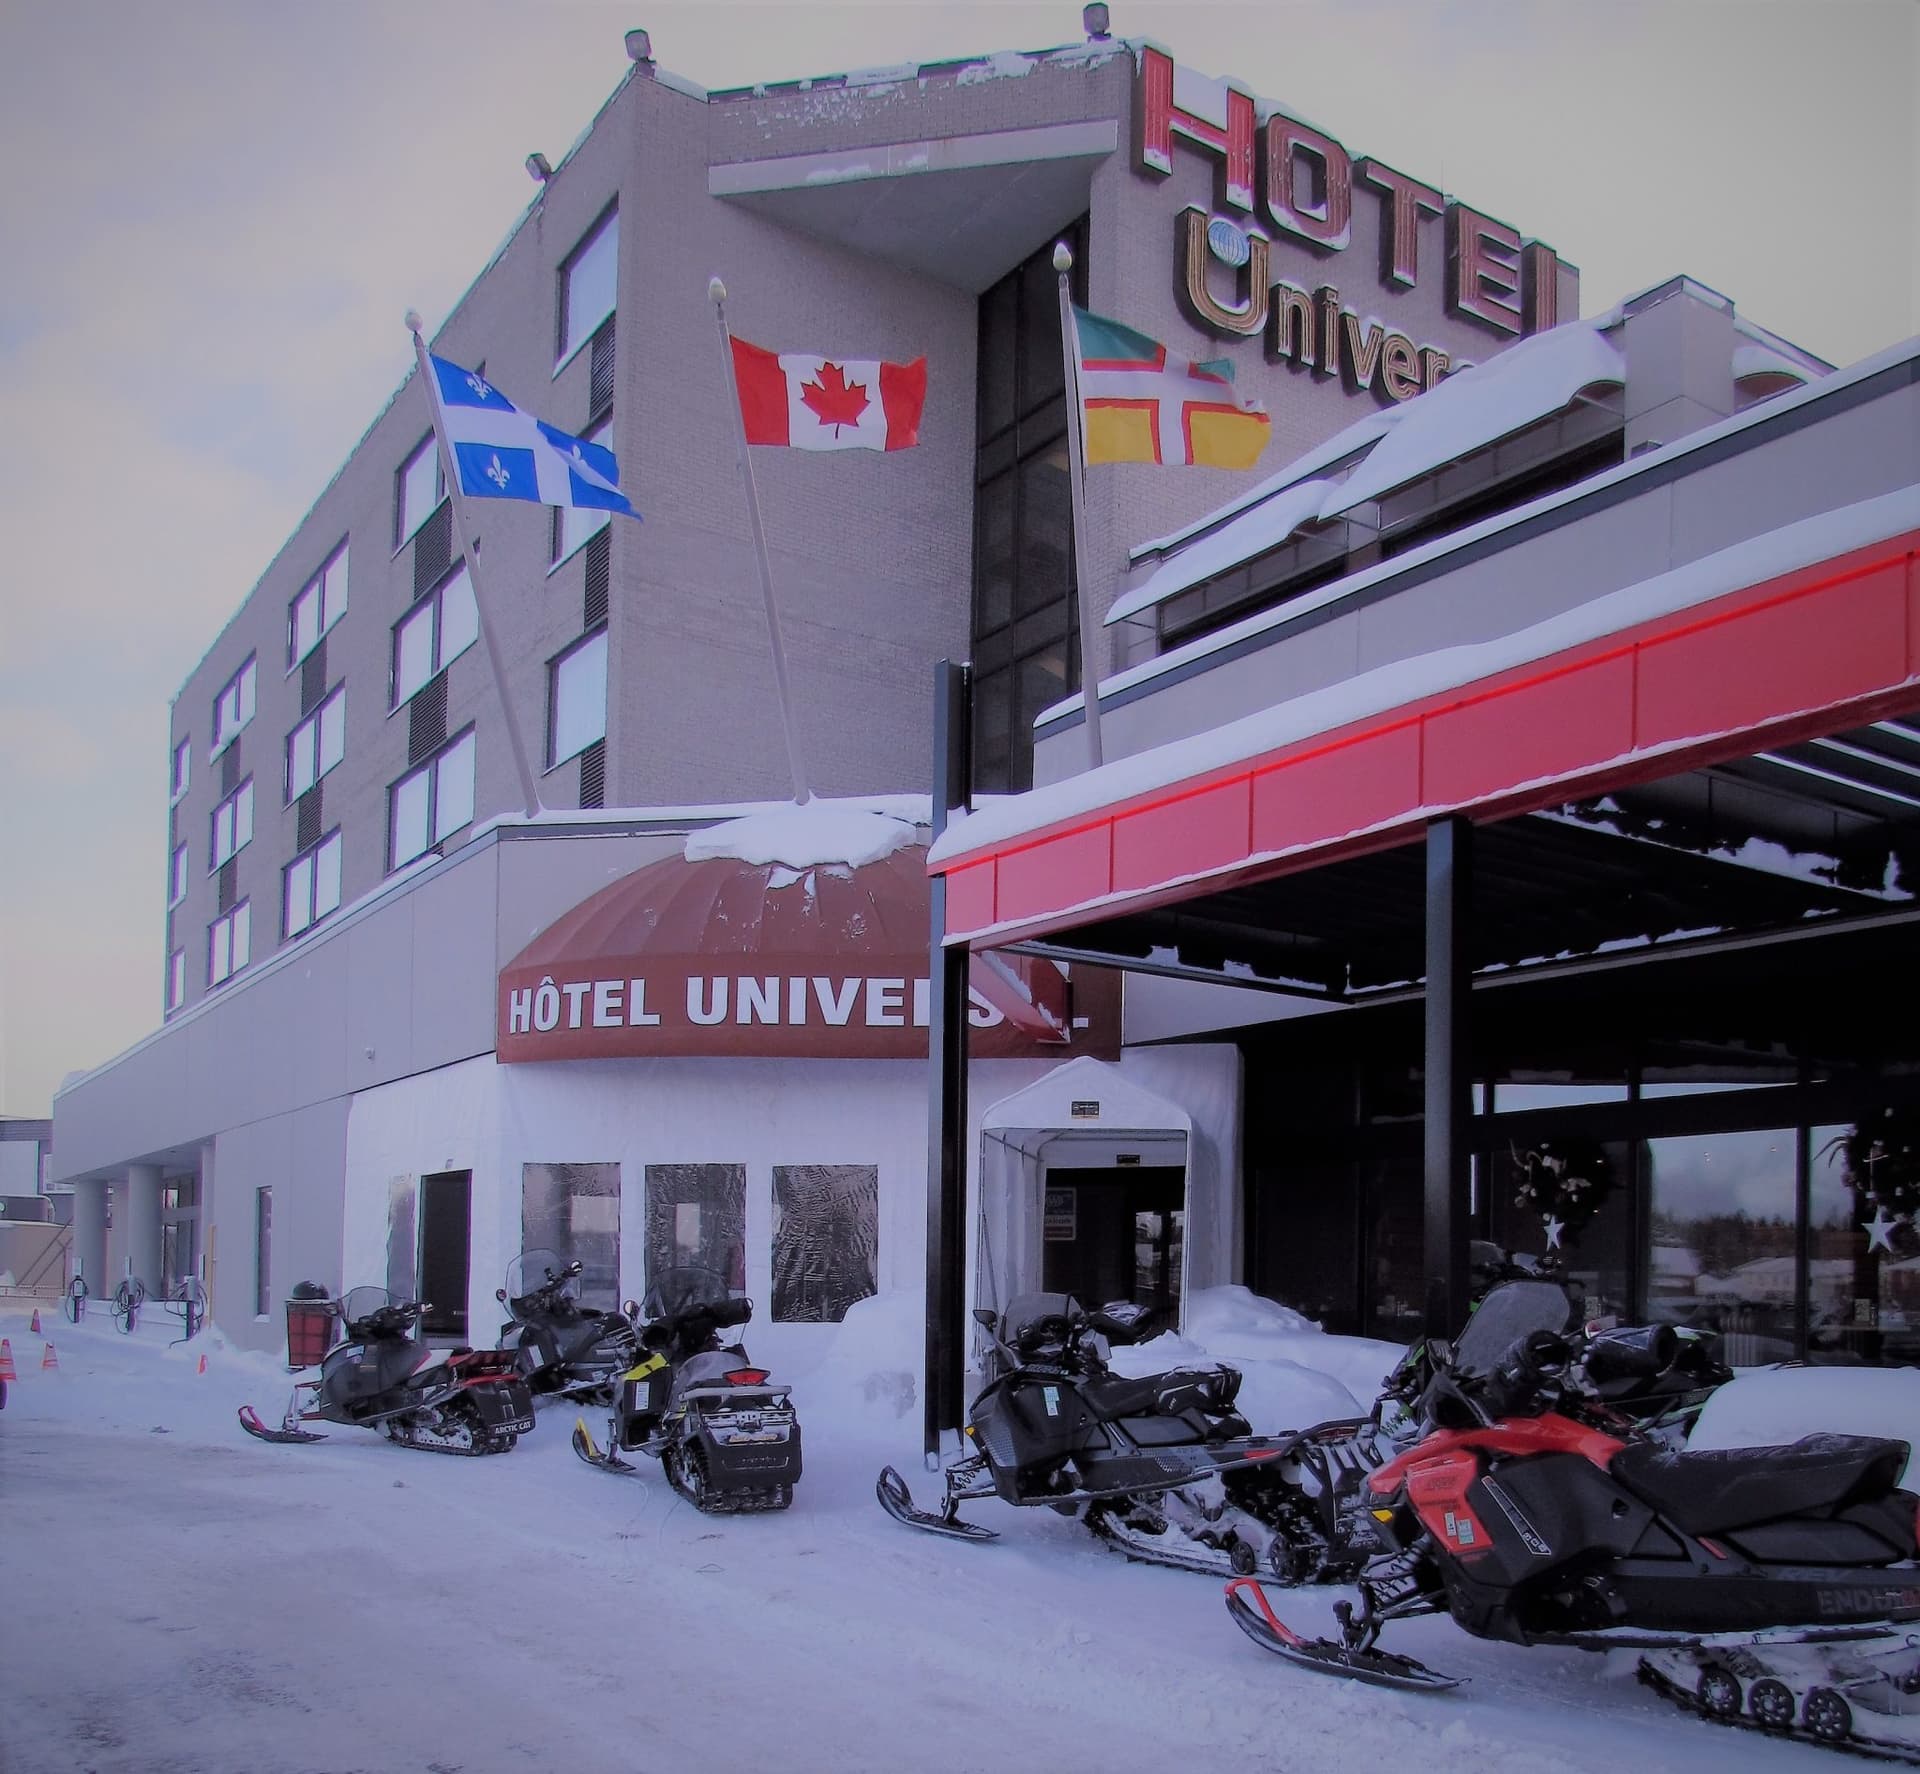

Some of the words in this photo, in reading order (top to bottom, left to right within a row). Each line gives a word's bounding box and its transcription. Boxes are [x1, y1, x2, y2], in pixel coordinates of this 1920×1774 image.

[1177, 206, 1460, 401] Univer
[510, 975, 661, 1034] HÔTEL
[687, 976, 1089, 1028] UNIVES
[495, 1424, 518, 1434] ARCTIC
[519, 1421, 531, 1430] CAT
[1816, 1588, 1920, 1614] ENDU
